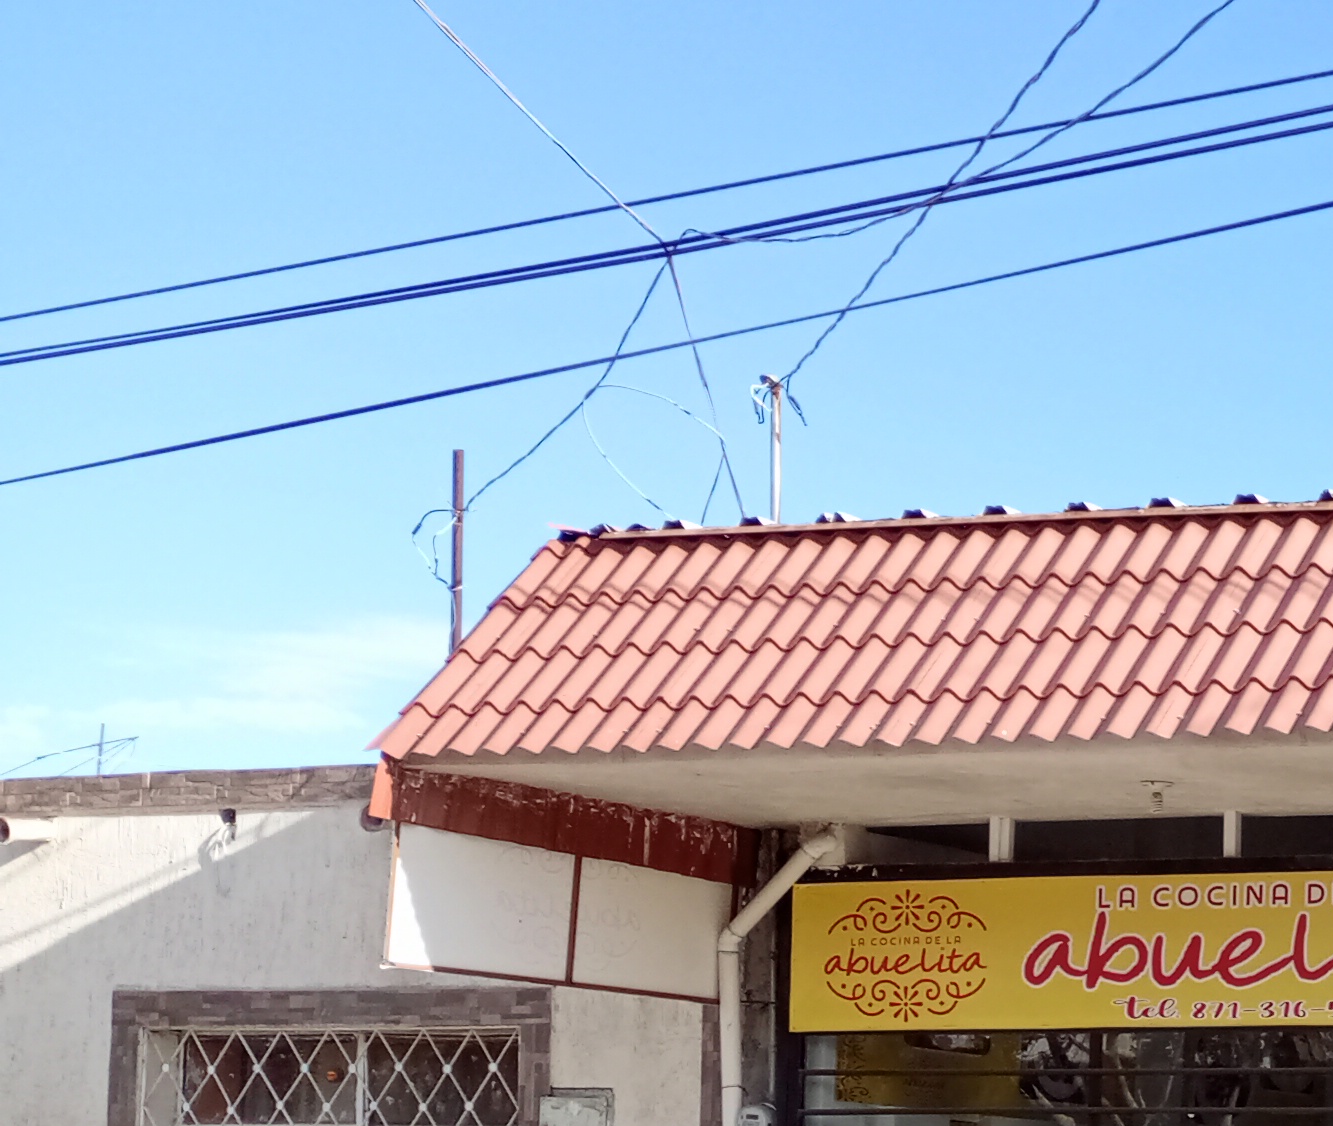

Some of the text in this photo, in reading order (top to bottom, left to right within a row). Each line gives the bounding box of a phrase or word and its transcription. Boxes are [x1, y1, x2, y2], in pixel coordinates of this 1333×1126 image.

[1097, 886, 1136, 909] LA
[1152, 883, 1290, 907] COCINA
[850, 935, 962, 947] LA COCINA DE LA
[824, 946, 987, 977] abuelita
[1112, 995, 1180, 1020] tel.
